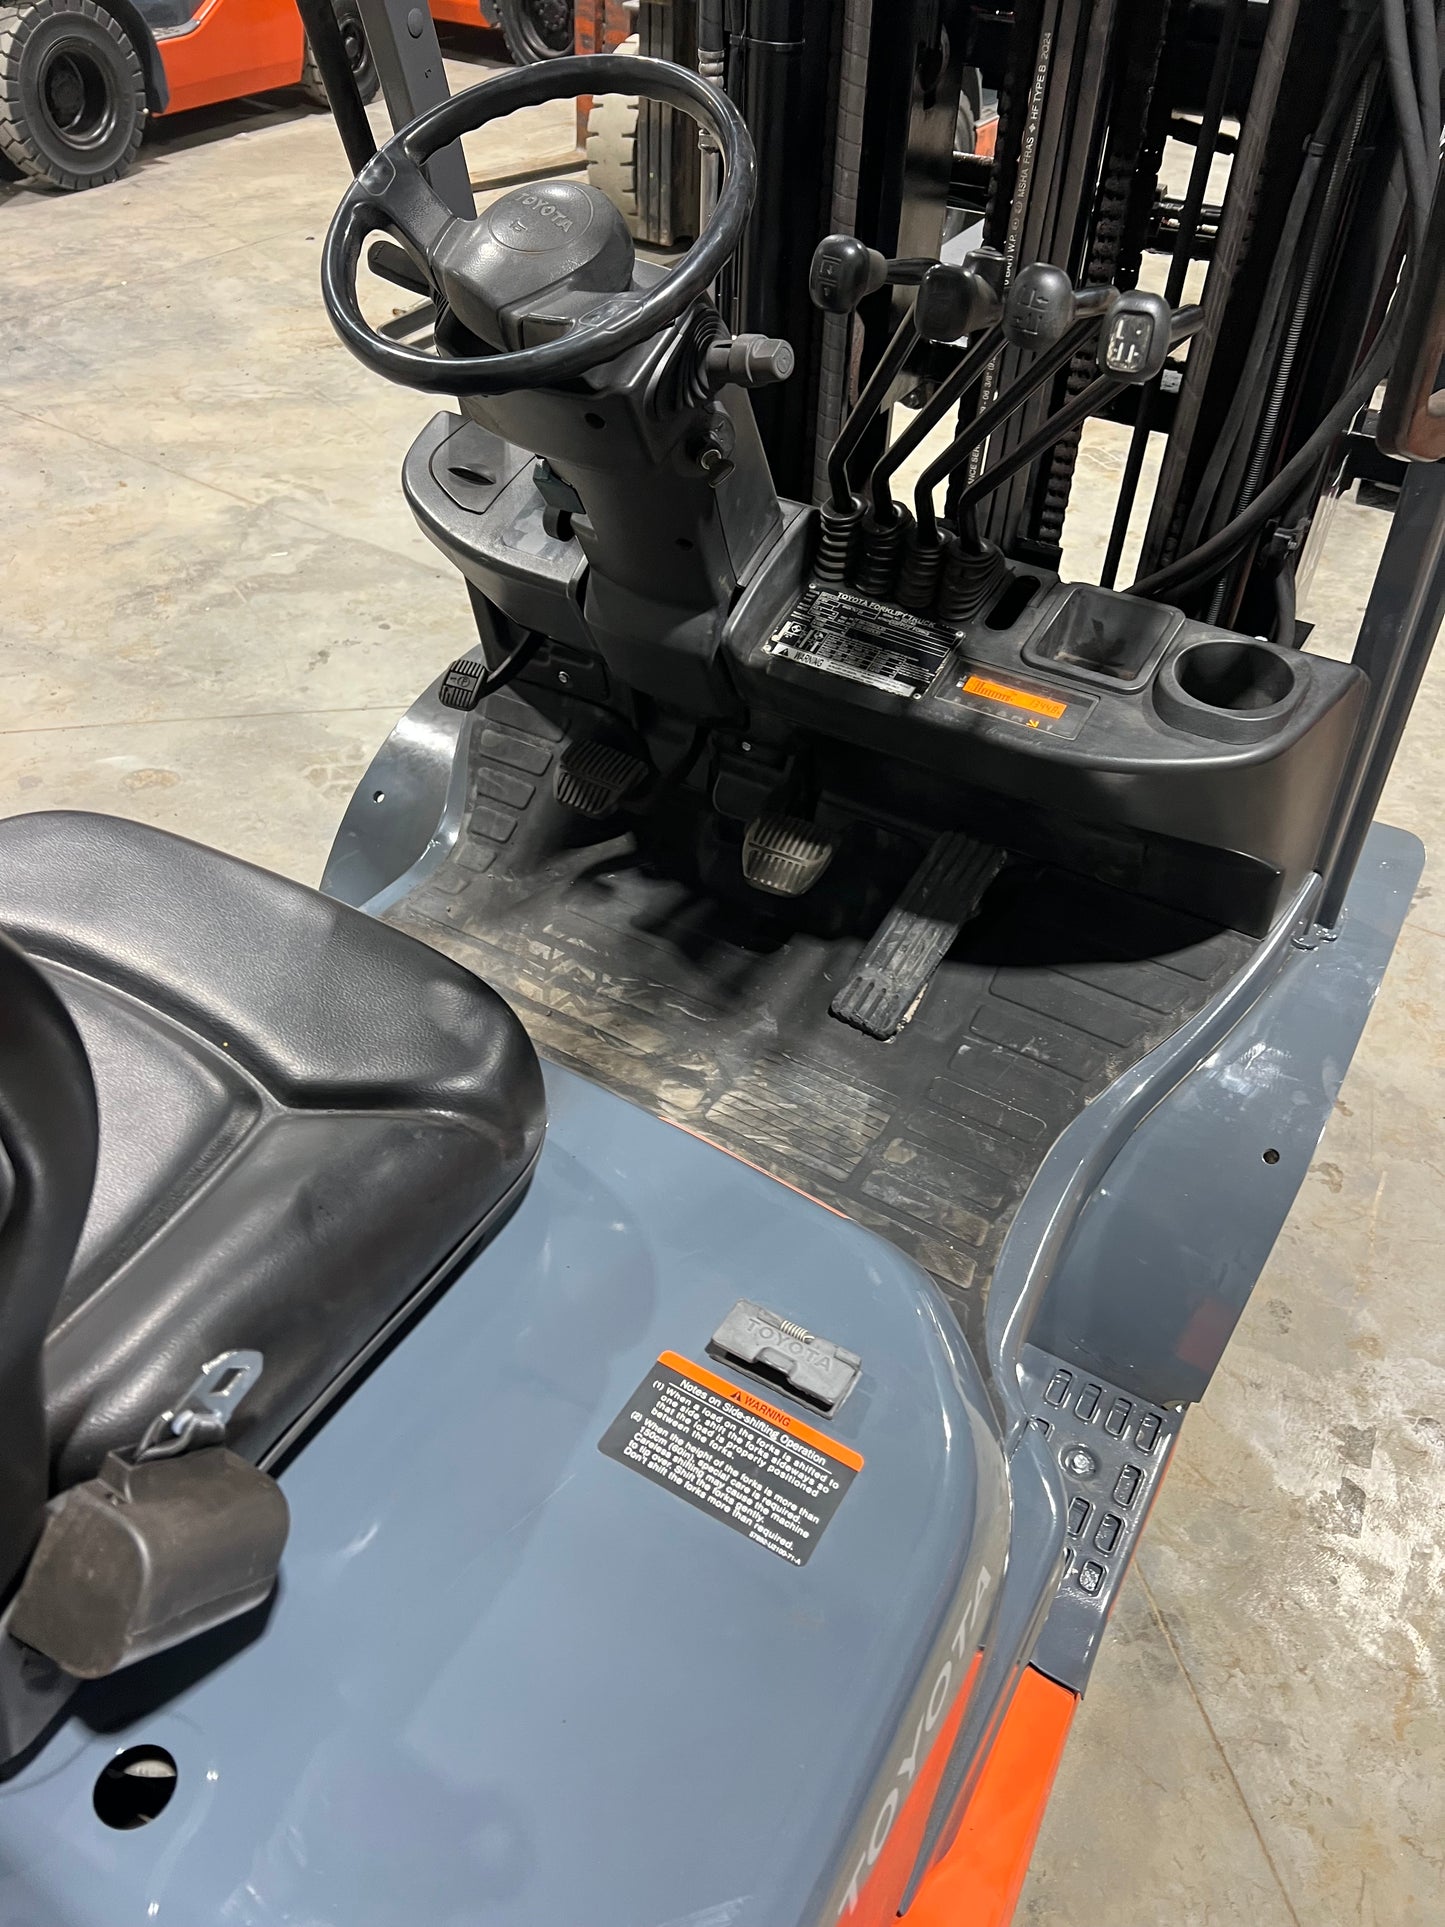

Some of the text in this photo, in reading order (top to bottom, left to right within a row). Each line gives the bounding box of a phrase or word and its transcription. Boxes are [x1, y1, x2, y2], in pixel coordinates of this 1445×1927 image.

[1030, 104, 1039, 120] HF
[1033, 74, 1045, 102] TYPE
[1022, 136, 1034, 164] FRAS
[1018, 168, 1029, 198] MSHA
[515, 192, 573, 233] TOYOTA
[1008, 234, 1017, 253] W.P.
[838, 592, 868, 606] TOYOTA
[870, 602, 908, 619] FORKLIFT
[908, 614, 936, 628] TRUCK
[793, 651, 825, 667] WARNING
[747, 1317, 832, 1372] TOYOTA
[650, 1407, 734, 1459] between the forks.
[652, 1380, 839, 1489] (1) When a load on the forks is shifted to
[679, 1379, 825, 1465] Notes on Side-shifting Operation
[744, 1395, 791, 1427] WARNING
[630, 1410, 819, 1524] (2) When the height of the forks is more than
[655, 1400, 818, 1496] that the load is properly positioned
[660, 1394, 678, 1407] one
[704, 1419, 726, 1434] shift
[727, 1430, 743, 1444] the
[744, 1440, 769, 1459] forks
[770, 1456, 814, 1485] sideways
[816, 1482, 829, 1493] so
[623, 1446, 793, 1550] Don't shift the forks more than required.
[628, 1439, 764, 1523] to tip over. Shift the forks gently.
[633, 1432, 809, 1538] Careless shifting may cause the machine
[639, 1426, 667, 1445] 150cm
[697, 1459, 730, 1481] special
[729, 1478, 750, 1493] care
[751, 1490, 760, 1499] is
[761, 1496, 800, 1524] required.
[838, 1565, 992, 1917] TOYOTA
